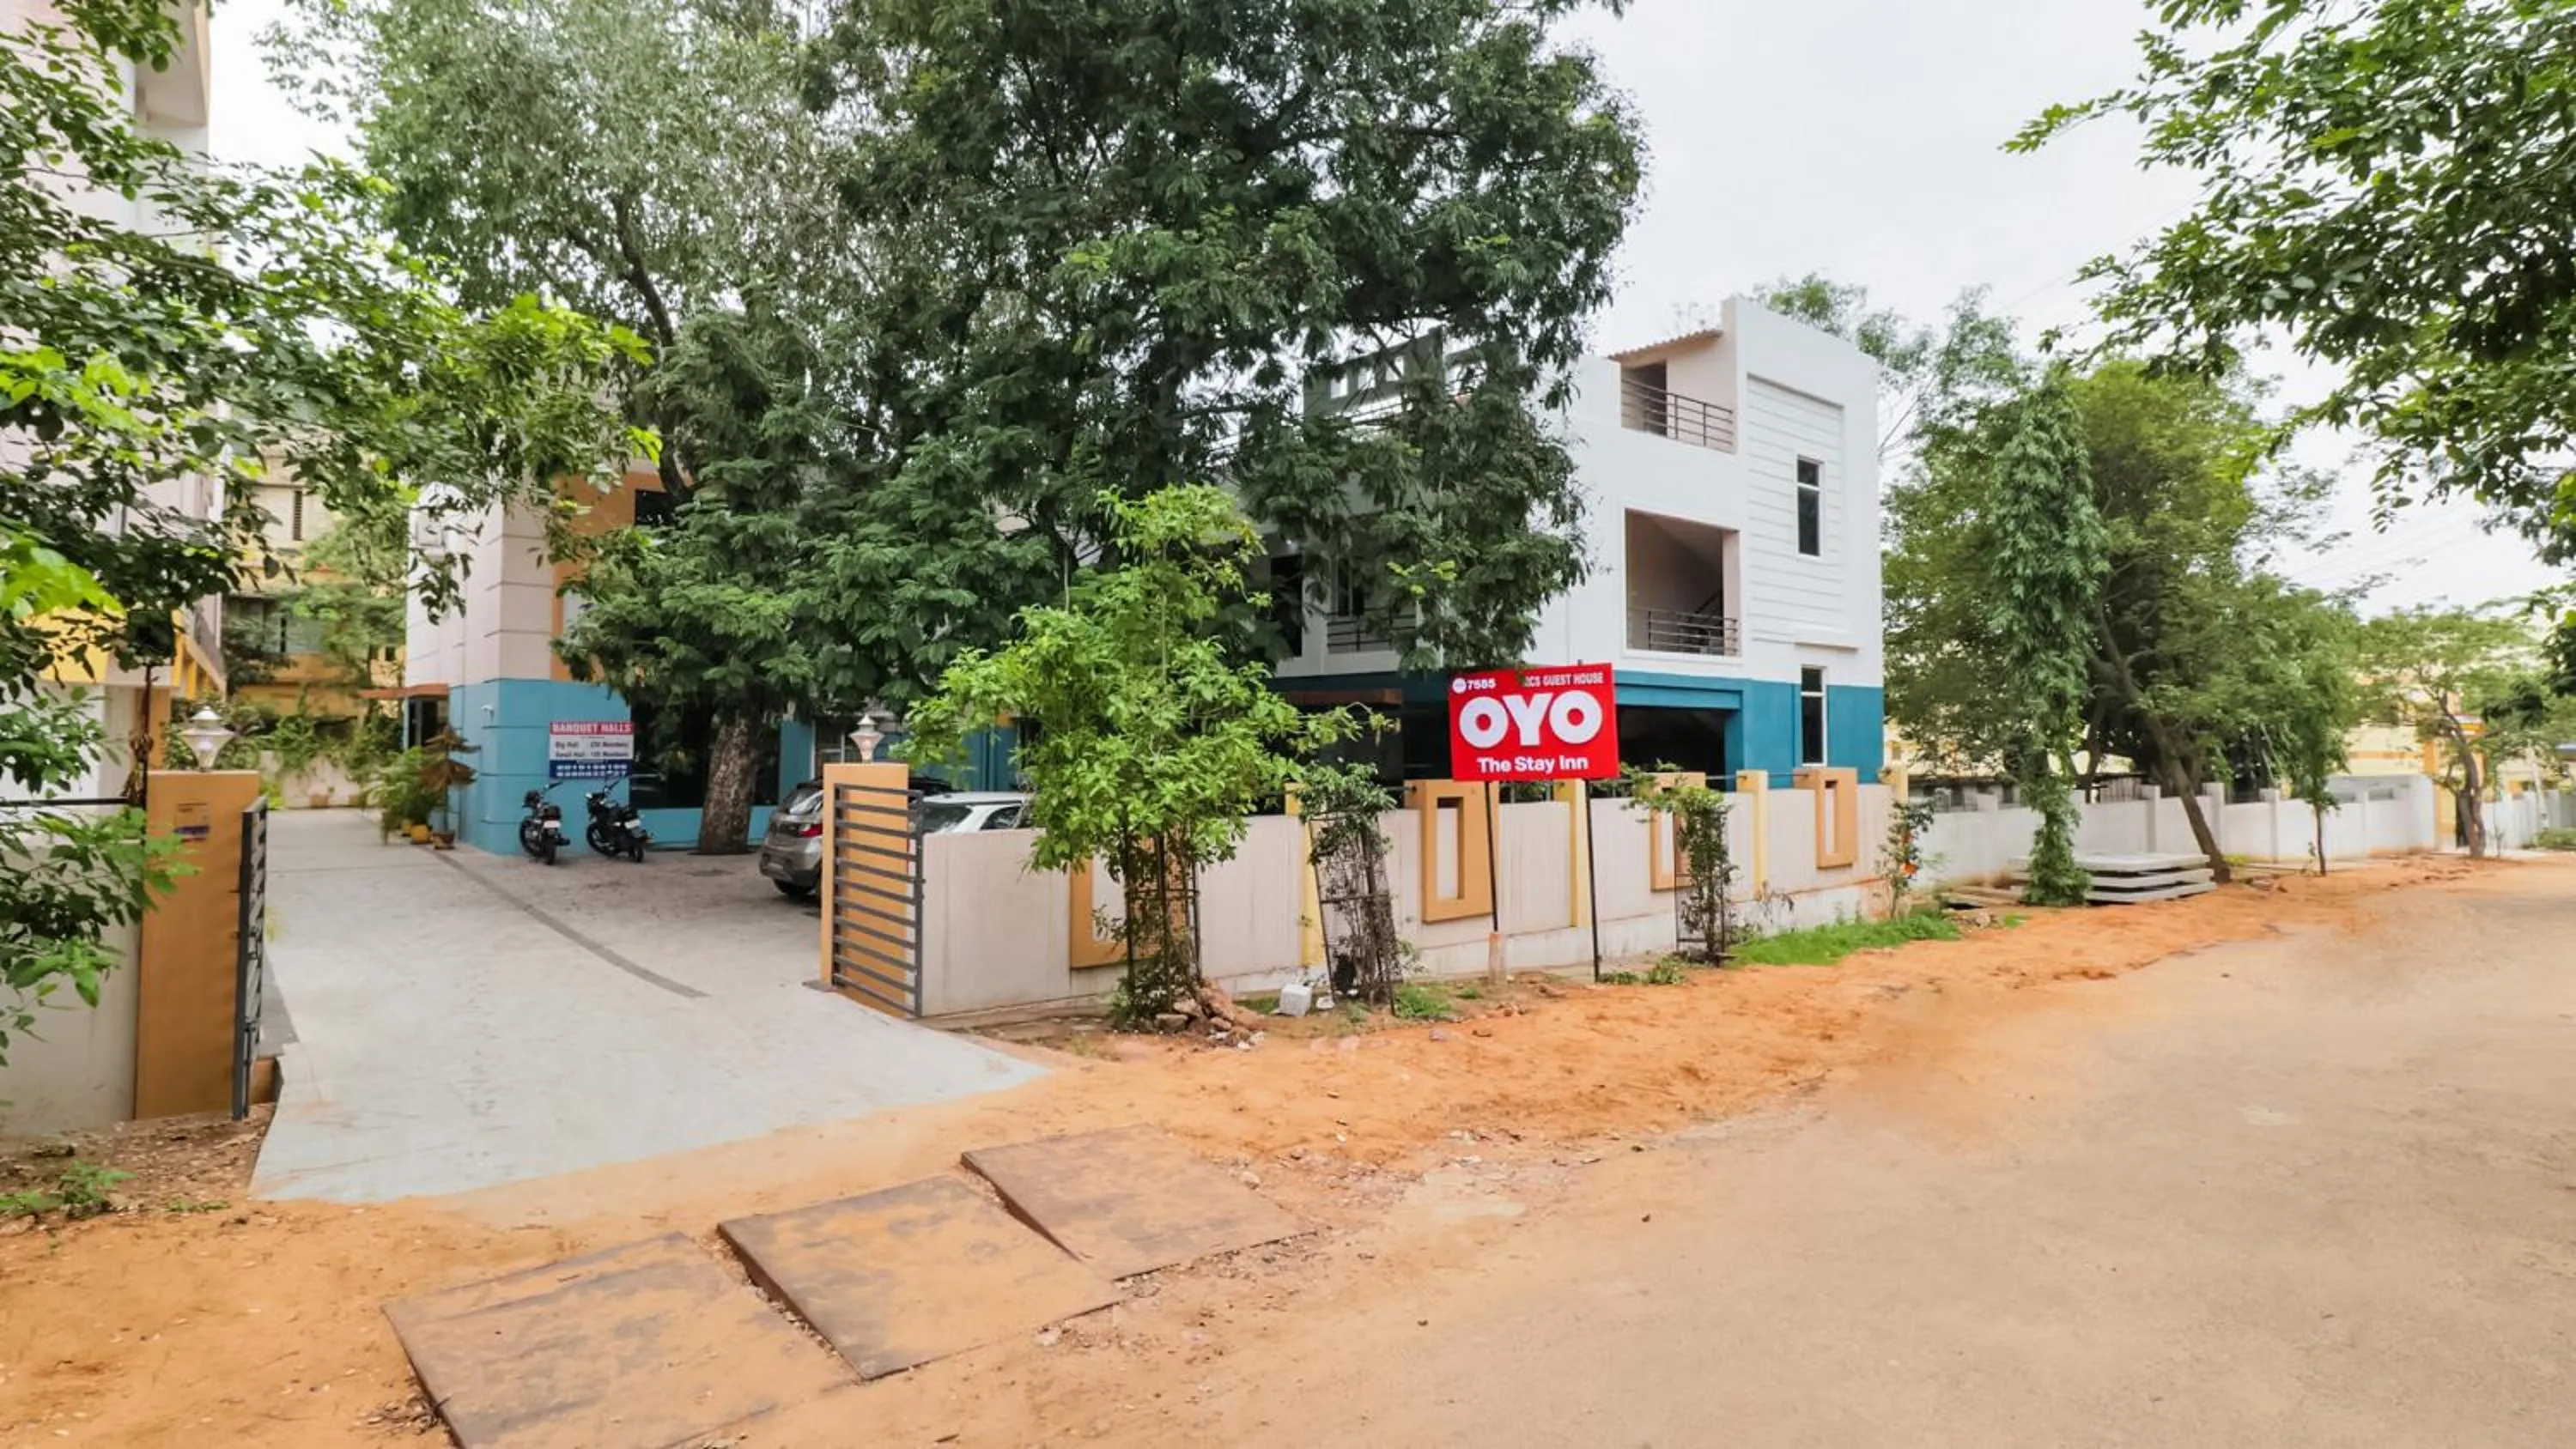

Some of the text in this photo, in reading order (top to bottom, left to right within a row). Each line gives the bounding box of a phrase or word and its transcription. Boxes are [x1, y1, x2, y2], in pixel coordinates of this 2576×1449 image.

[1542, 674, 1571, 686] GUEST
[1573, 672, 1605, 684] HOUSE
[552, 722, 632, 732] BANQUET HALLS
[1459, 690, 1603, 749] OYO
[1477, 755, 1589, 774] The Stay Inn
